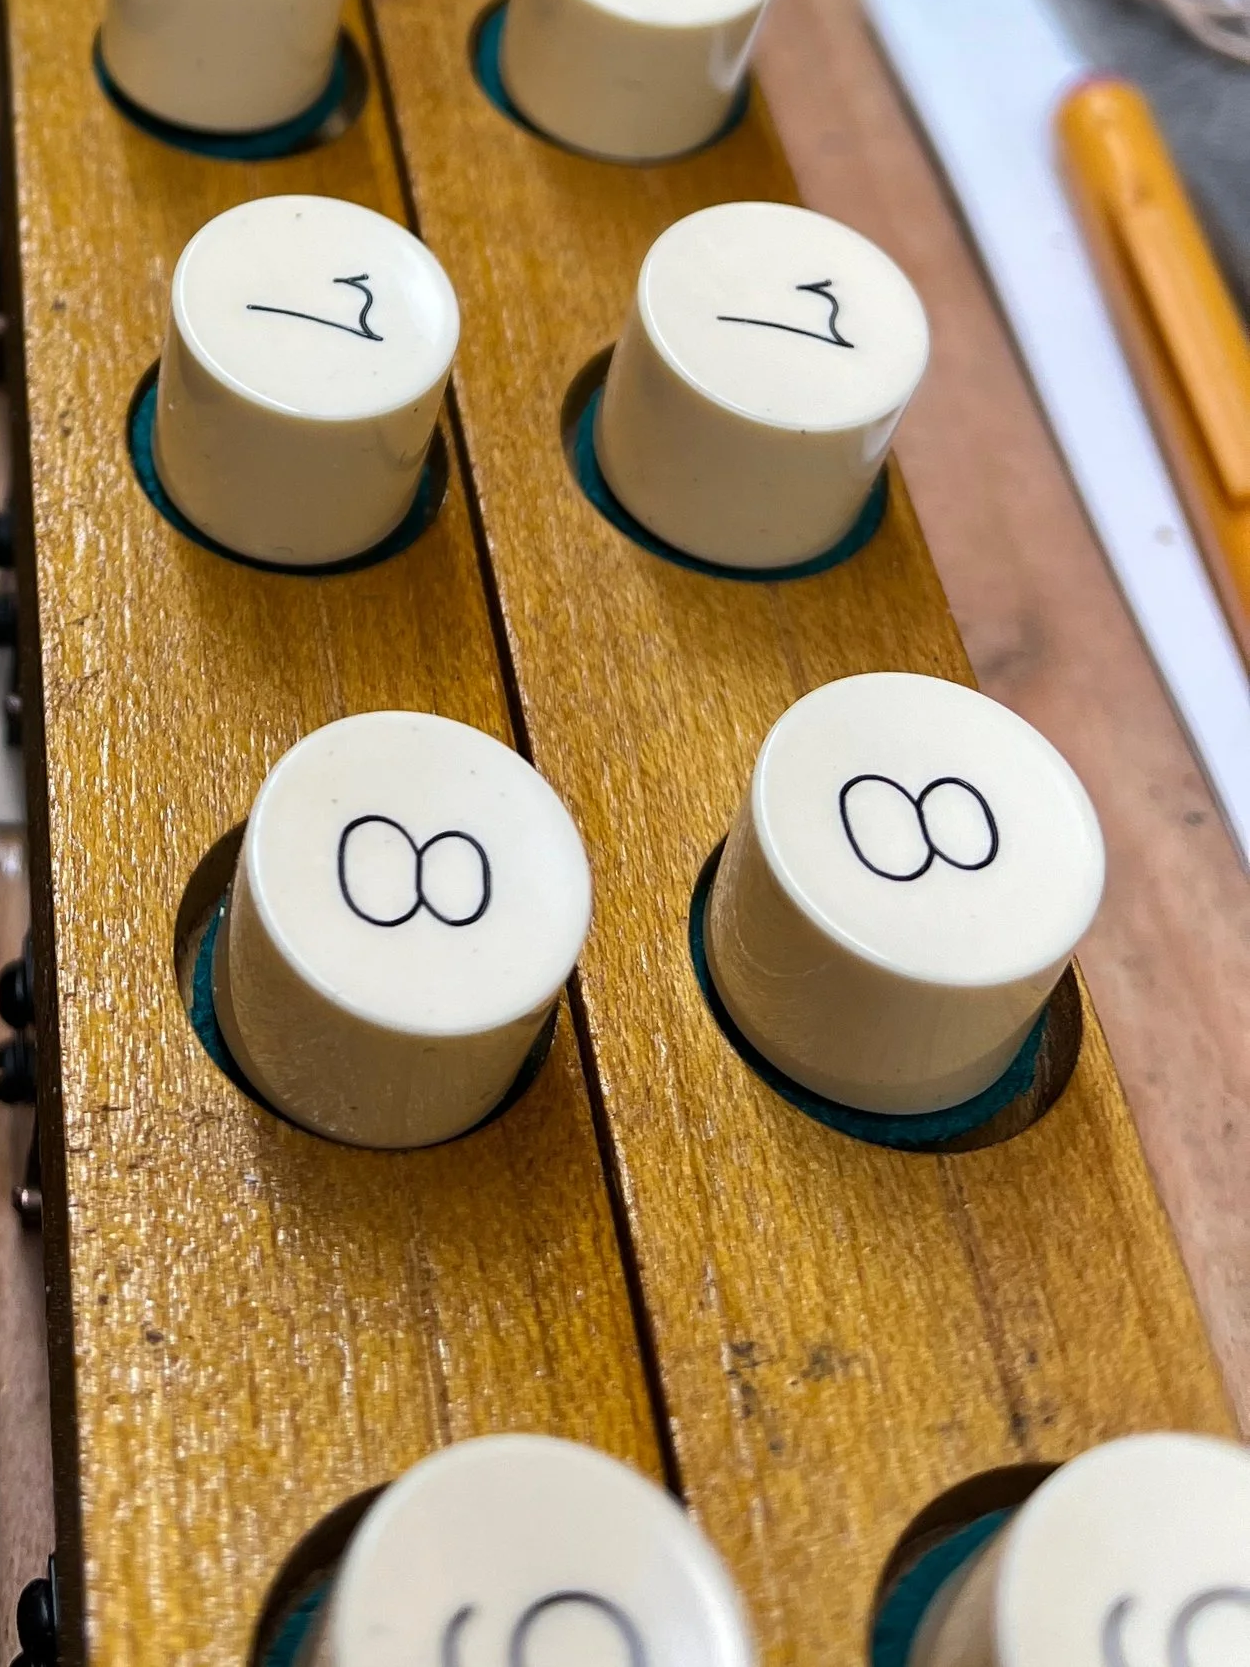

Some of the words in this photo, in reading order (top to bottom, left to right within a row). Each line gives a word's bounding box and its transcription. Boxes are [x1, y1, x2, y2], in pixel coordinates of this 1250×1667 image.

[247, 273, 383, 341] 7
[716, 280, 854, 348] 7
[337, 815, 492, 927] 8
[839, 775, 999, 882] 8
